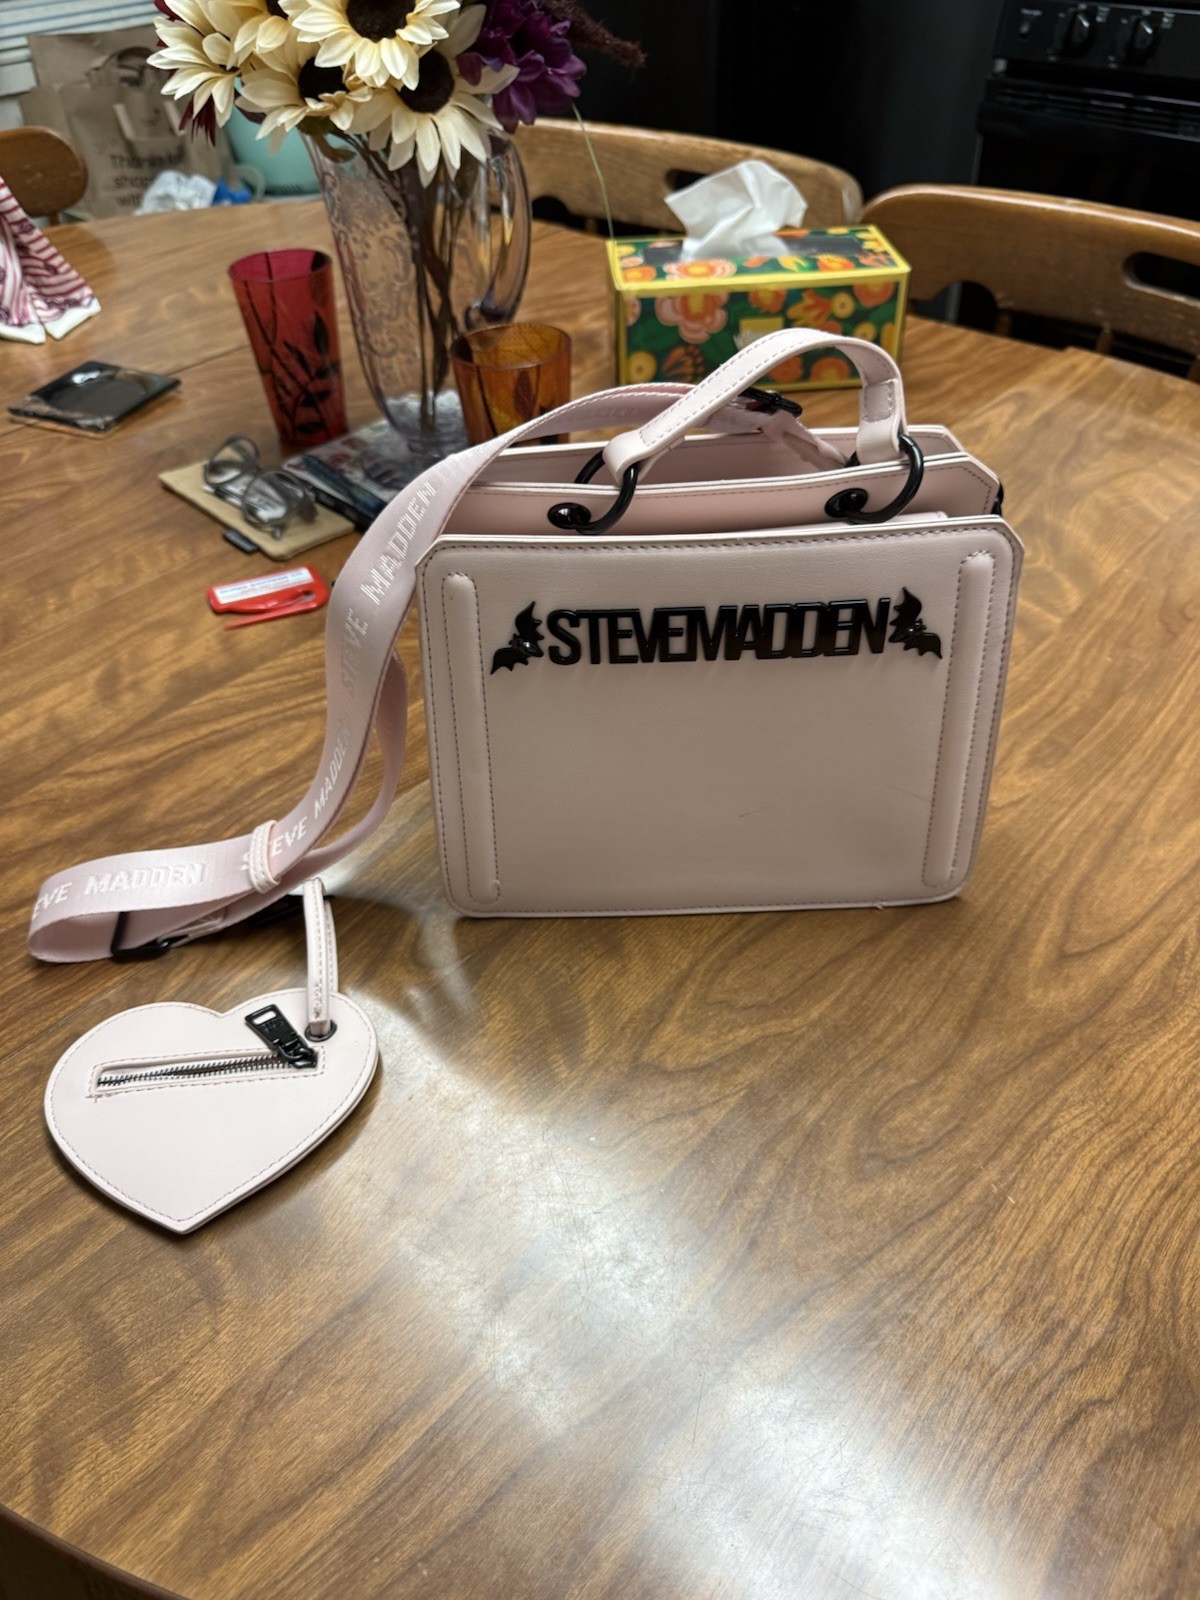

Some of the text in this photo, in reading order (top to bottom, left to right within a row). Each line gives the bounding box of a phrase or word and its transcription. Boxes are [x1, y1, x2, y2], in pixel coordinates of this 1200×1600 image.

[360, 481, 437, 606] MADDEN
[32, 862, 208, 920] EVE MADDEN
